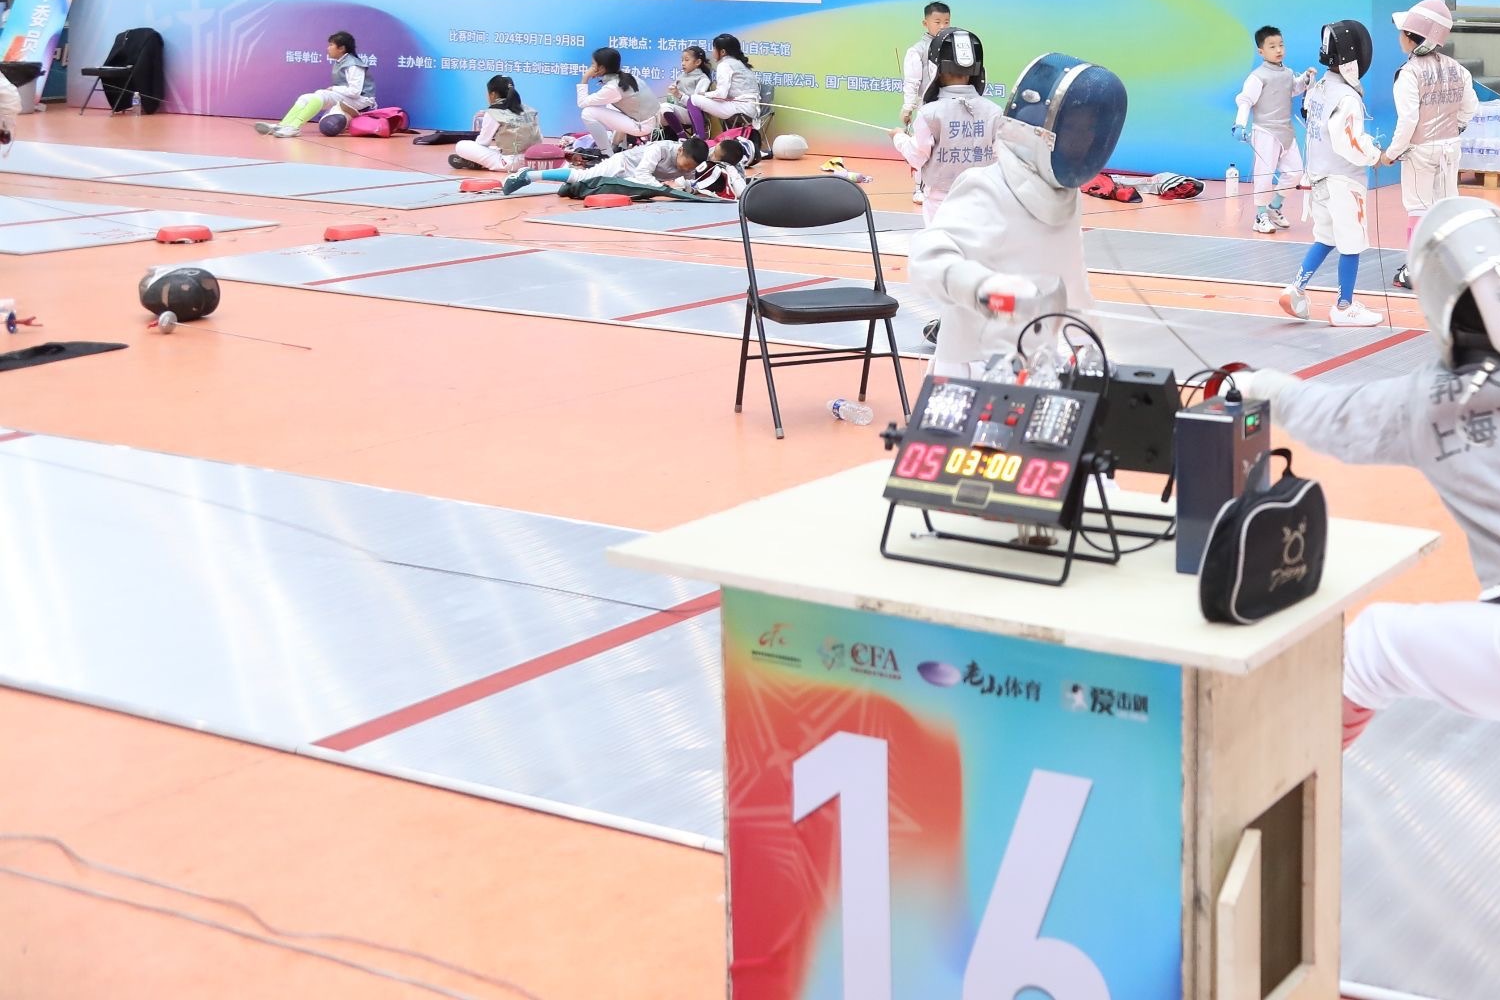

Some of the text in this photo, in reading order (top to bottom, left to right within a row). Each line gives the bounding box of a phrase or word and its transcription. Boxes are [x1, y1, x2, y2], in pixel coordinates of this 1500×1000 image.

[896, 442, 947, 481] 05
[945, 448, 1022, 483] 03:00
[1014, 458, 1070, 497] 02
[850, 641, 899, 673] CFA
[962, 659, 1042, 702] 老山体育
[793, 729, 1113, 1000] 16
